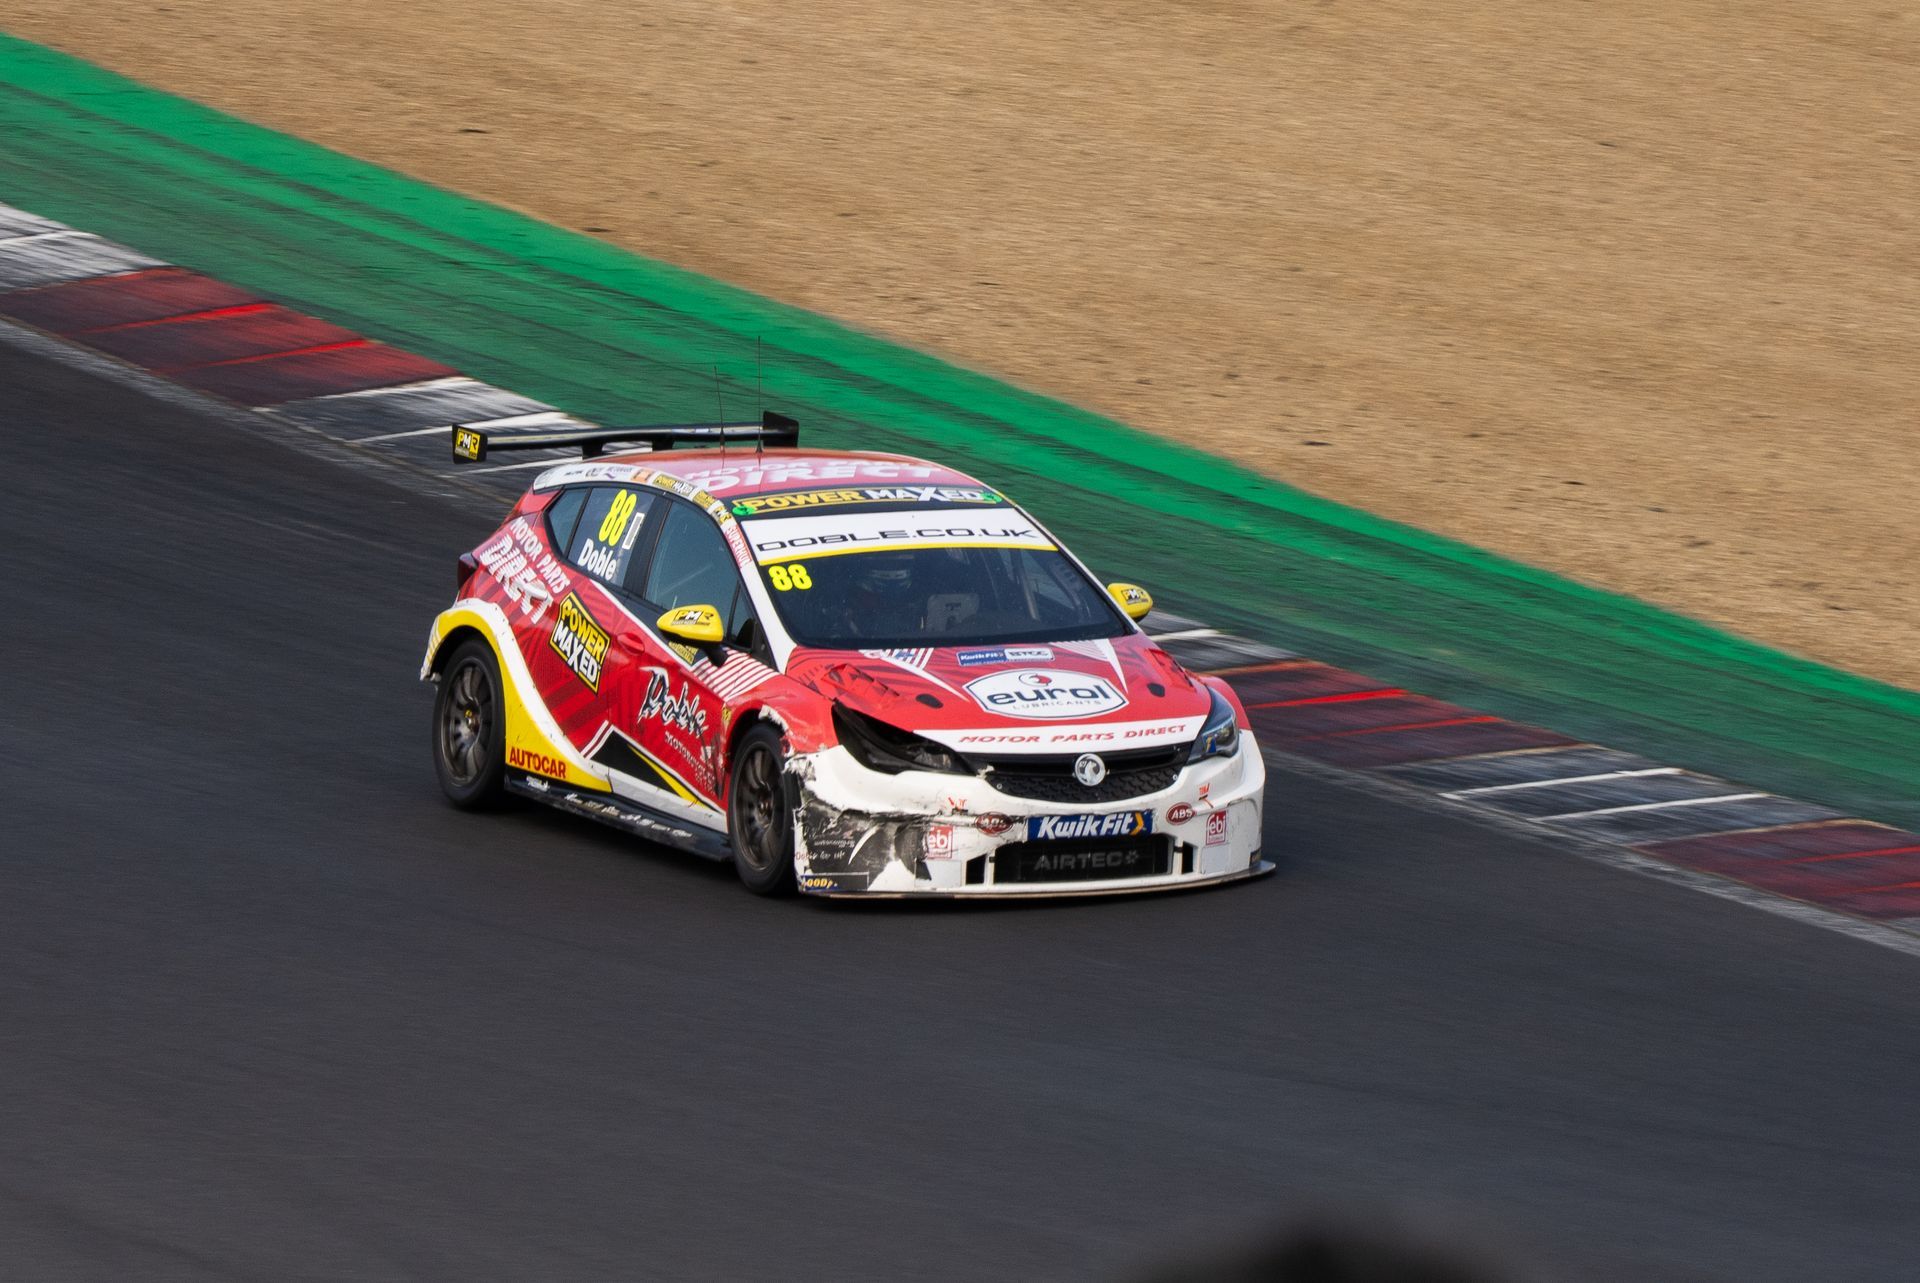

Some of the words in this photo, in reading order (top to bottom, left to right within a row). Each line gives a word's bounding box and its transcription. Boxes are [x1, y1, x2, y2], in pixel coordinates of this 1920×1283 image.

[691, 465, 942, 493] DIRECT
[748, 490, 864, 510] POWER
[864, 486, 985, 502] MAXED
[599, 488, 637, 547] 88
[756, 527, 1039, 552] DOBLE.CO.UK
[510, 516, 543, 562] MOTOR
[536, 554, 571, 594] PARTS
[577, 538, 617, 581] Doble
[480, 533, 554, 624] DIRECT
[768, 563, 813, 592] 88
[562, 598, 605, 664] POWER
[554, 620, 598, 684] MAXED
[987, 684, 1112, 705] eurol
[1012, 699, 1102, 710] LUBRICANTS
[958, 735, 1041, 743] MOTOR
[1049, 732, 1115, 742] PARTS
[1124, 724, 1187, 738] DIRECT
[509, 746, 567, 779] AUTOCAR
[1171, 808, 1193, 821] ABS
[1034, 851, 1123, 870] AIRTEC
